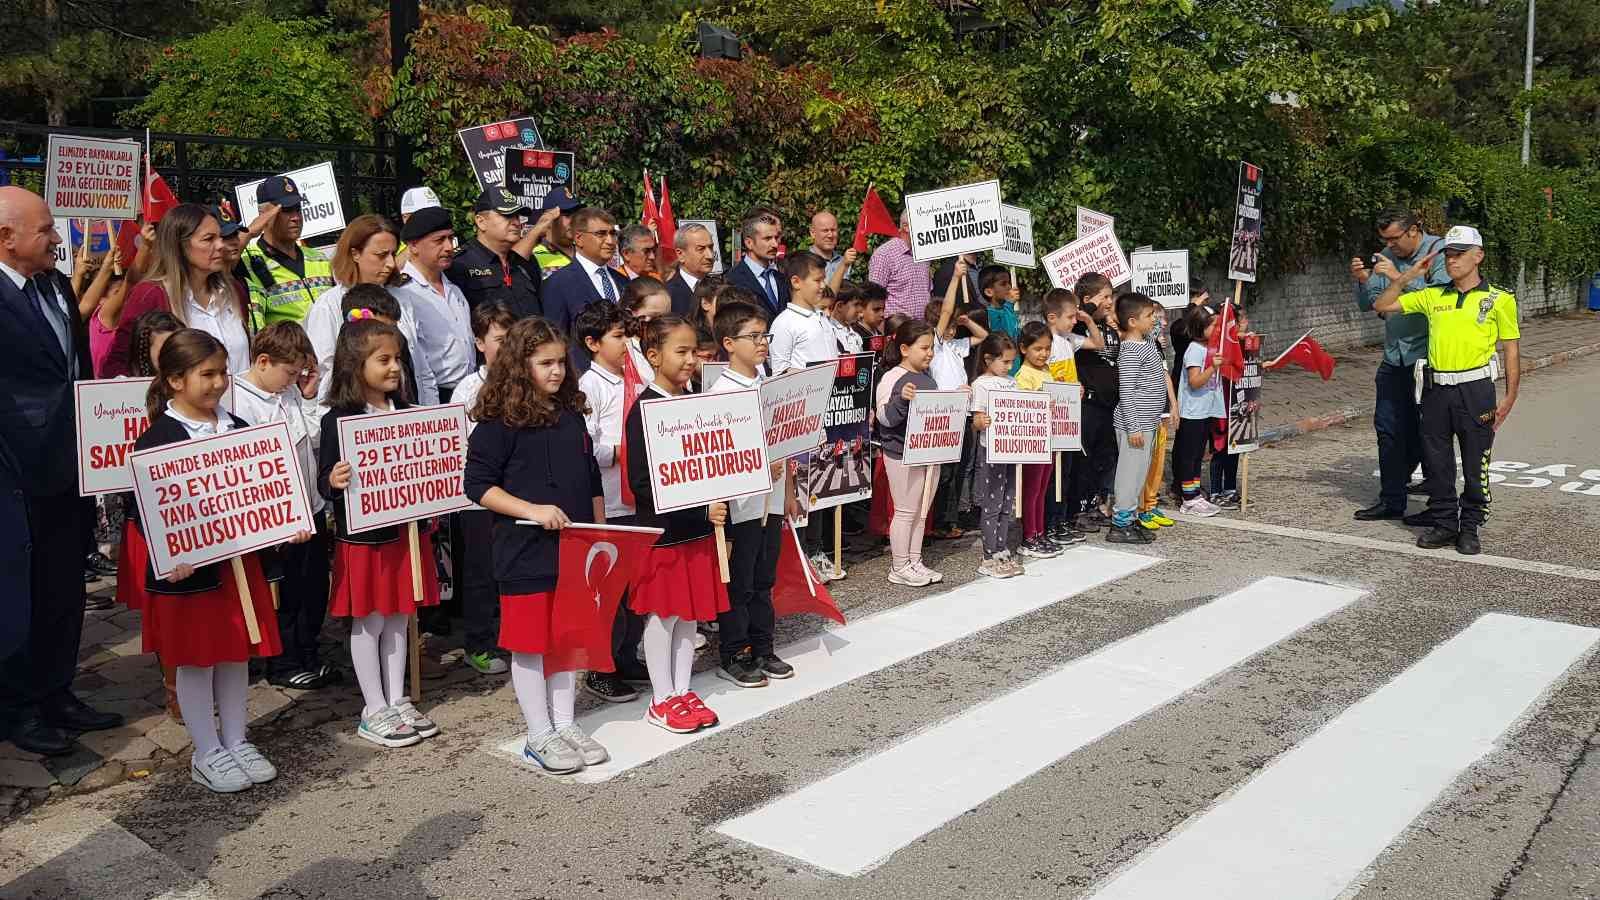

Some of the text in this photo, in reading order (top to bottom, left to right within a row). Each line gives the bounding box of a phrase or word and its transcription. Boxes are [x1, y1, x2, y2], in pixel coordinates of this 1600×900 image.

[57, 160, 73, 173] 29
[484, 168, 504, 183] SAY
[56, 175, 76, 189] YAYA
[303, 201, 335, 222] RUŞU
[934, 208, 976, 228] HAYATA
[917, 227, 951, 246] SAYGI
[1057, 266, 1069, 279] 29
[1100, 243, 1115, 256] DE
[1146, 271, 1172, 284] HAYATA
[1135, 284, 1156, 297] SAYGI
[771, 398, 807, 427] HAYATA
[994, 411, 1006, 422] 29
[397, 417, 460, 439] BAYRAKLARLA
[924, 415, 950, 432] HAYATA
[681, 428, 735, 457] HAYATA
[909, 432, 931, 449] SAYGI
[90, 442, 134, 470] SAY
[202, 438, 282, 470] BAYRAKLARLA
[357, 449, 378, 468] 29
[440, 435, 461, 454] DE
[155, 483, 182, 506] 29
[258, 457, 288, 479] DE
[358, 467, 388, 489] YAYA
[659, 457, 704, 486] SAYGI
[159, 502, 197, 528] YAYA
